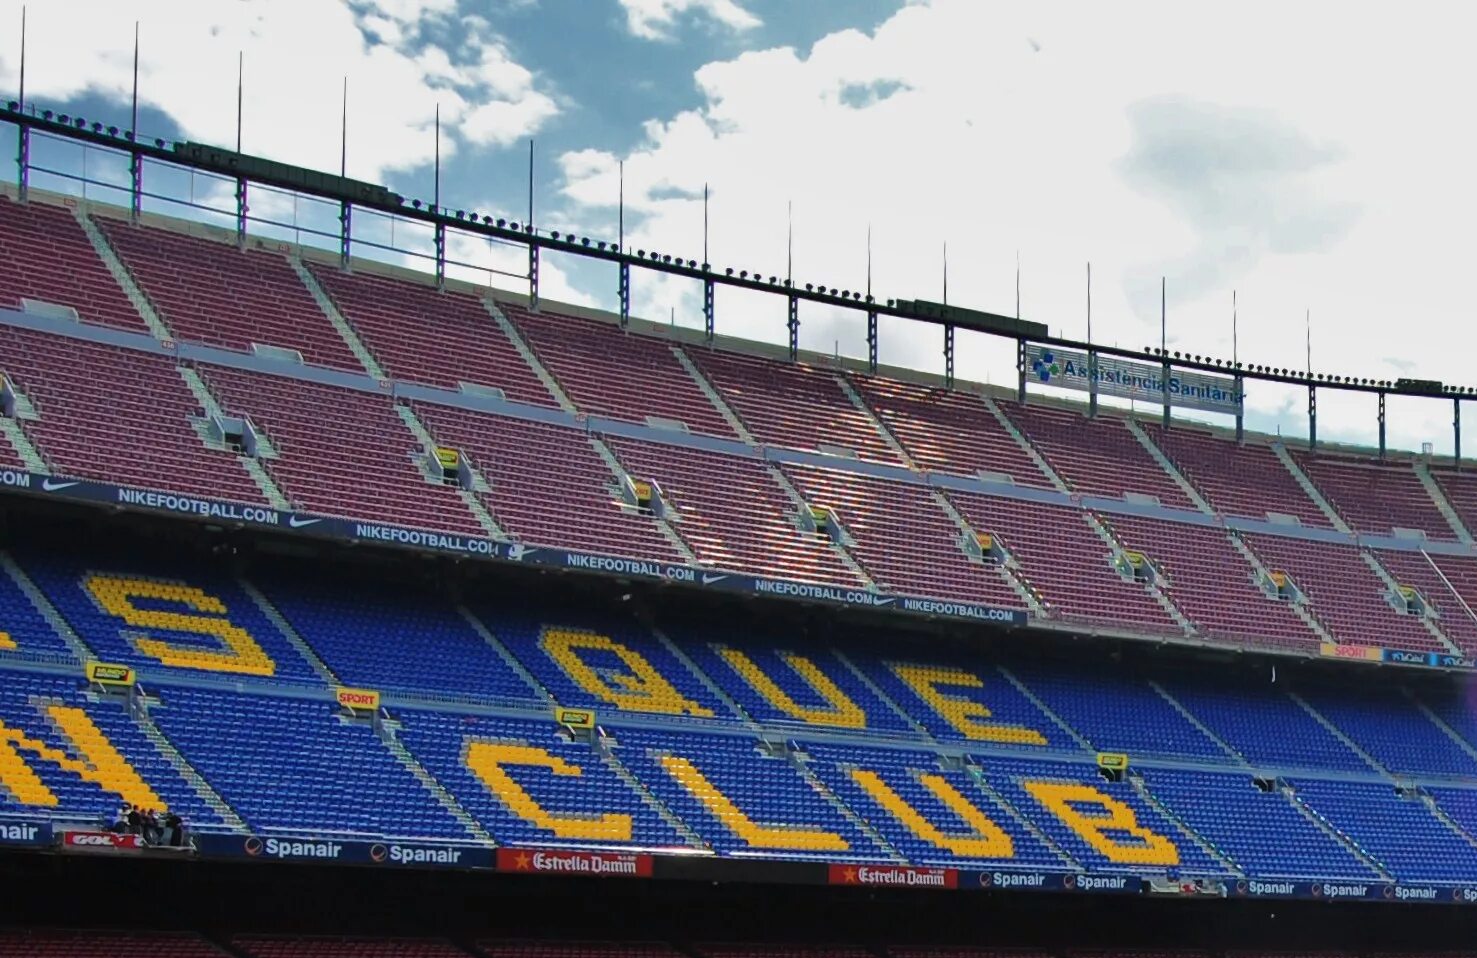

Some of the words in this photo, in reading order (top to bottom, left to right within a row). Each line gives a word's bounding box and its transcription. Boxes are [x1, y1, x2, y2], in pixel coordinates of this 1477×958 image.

[0, 470, 30, 488] OM
[119, 488, 279, 525] NIKEFOOTBALL.COM
[567, 554, 695, 581] NIKEFOOTBALL.COM
[755, 580, 873, 605] NIKEFOOTBALL.COM
[904, 599, 1013, 621] NIKEFOOTBALL.COM
[543, 628, 1048, 745] QUE
[339, 692, 376, 705] SPORT
[466, 742, 1180, 866] CLUB
[266, 839, 342, 858] Spanair
[390, 845, 461, 865] Spanair
[532, 852, 589, 873] Estrella
[591, 855, 637, 874] Damm
[858, 867, 906, 885] Estrella
[907, 870, 945, 886] Damm
[993, 872, 1045, 889] Spanair
[1077, 875, 1127, 891] Spanair
[1249, 881, 1295, 897] Spanair
[1323, 884, 1367, 899] Spanair
[1395, 887, 1438, 900] Spanair
